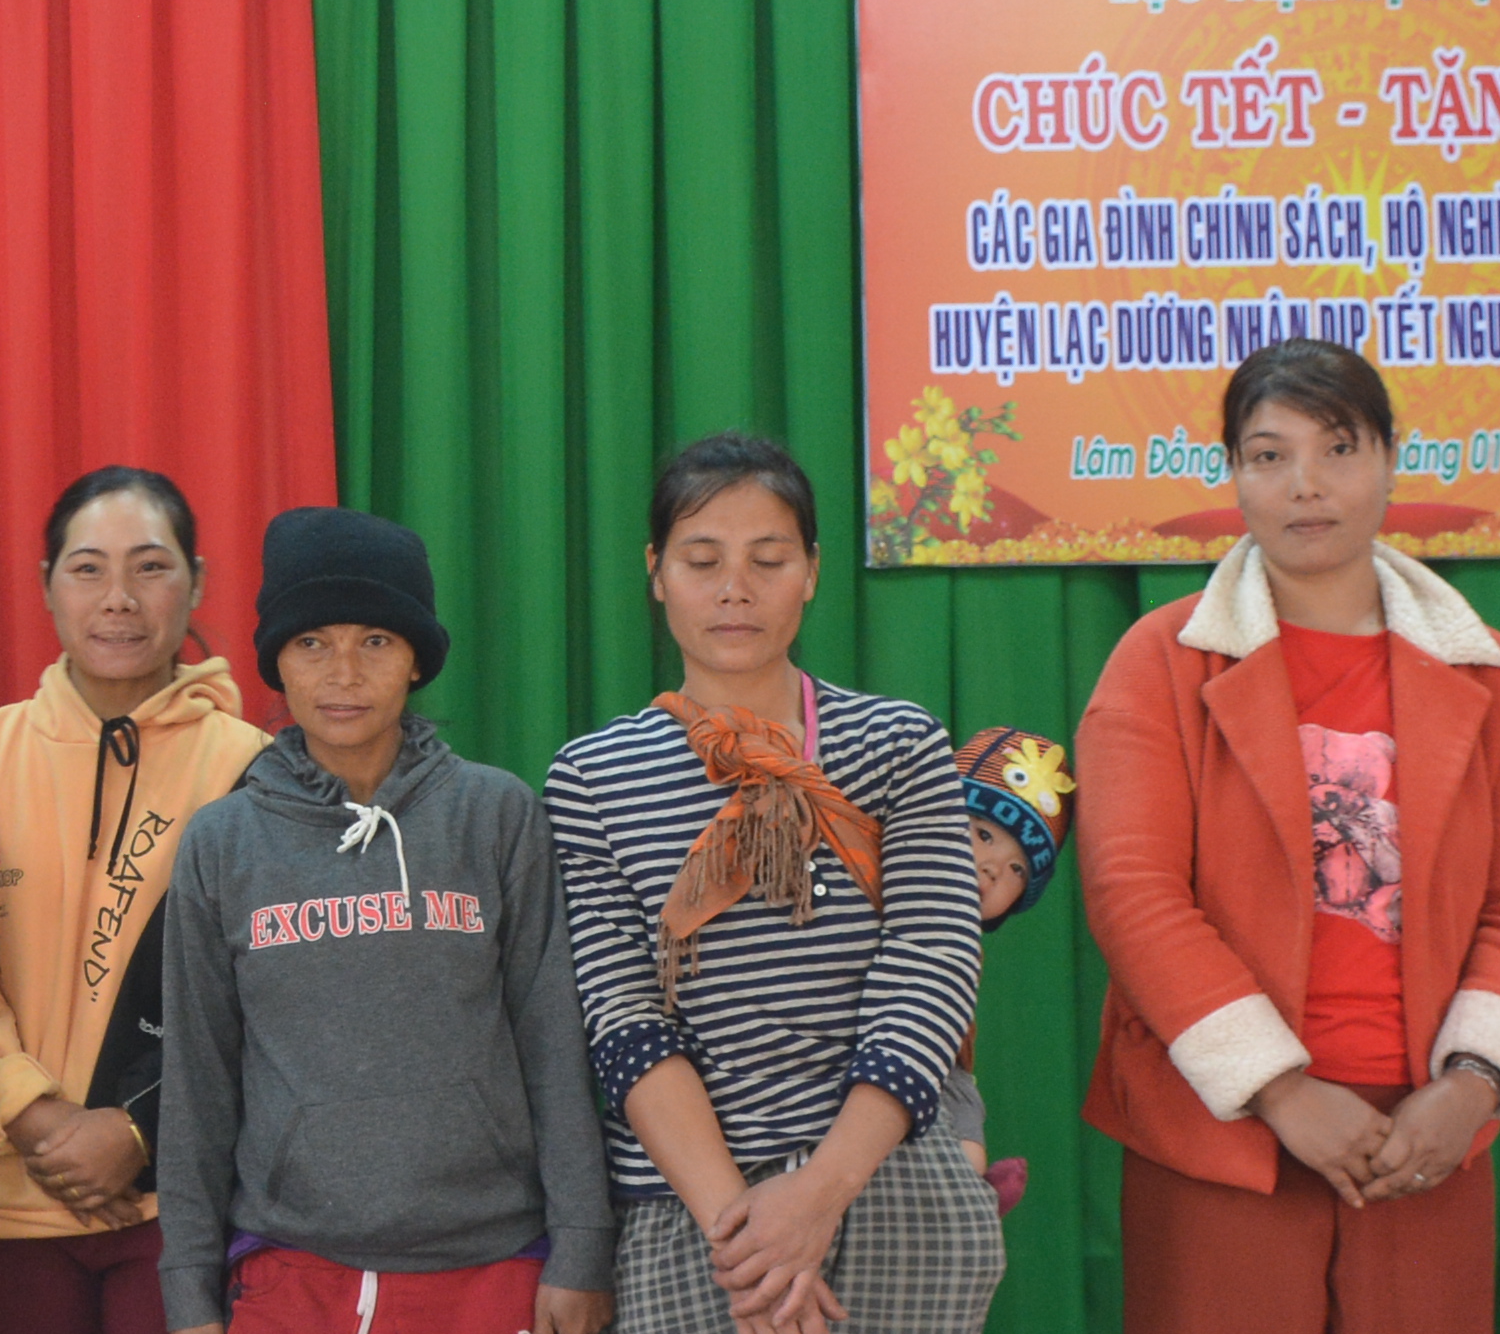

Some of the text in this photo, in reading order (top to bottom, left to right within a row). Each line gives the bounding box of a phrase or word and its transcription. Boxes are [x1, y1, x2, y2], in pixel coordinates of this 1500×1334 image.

[976, 54, 1165, 147] CHÚC
[1185, 38, 1320, 144] TẾT
[970, 192, 1034, 267] CÁC
[1042, 202, 1094, 265] GIA
[1104, 189, 1176, 264] ĐÌNH
[1185, 187, 1273, 262] CHÍNH
[1284, 186, 1375, 269] SÁCH,
[1385, 185, 1425, 273] HỘ
[932, 296, 1038, 382] HUYỆN
[1047, 304, 1106, 380] LẠC
[1116, 295, 1216, 367] DƯƠNG
[1378, 280, 1436, 361] TẾT
[1072, 437, 1135, 477] Lâm
[249, 890, 484, 950] EXCUSE ME
